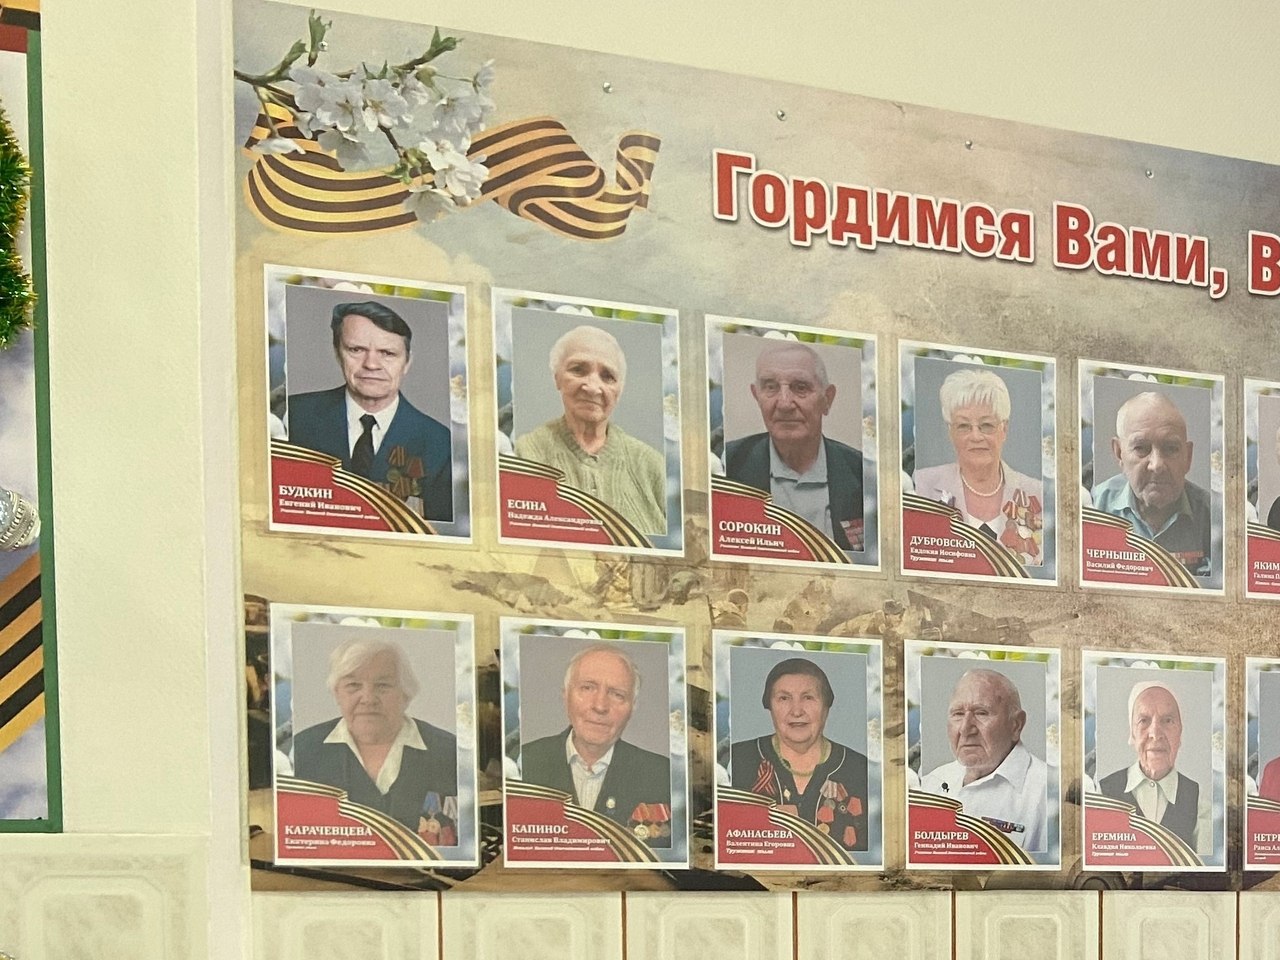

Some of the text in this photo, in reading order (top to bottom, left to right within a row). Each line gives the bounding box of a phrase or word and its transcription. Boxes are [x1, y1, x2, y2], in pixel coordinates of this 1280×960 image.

[713, 150, 1035, 261] Гордимся
[1054, 202, 1227, 296] Вами,
[279, 485, 333, 499] БУДКИН
[507, 499, 547, 511] ЕСИНА
[719, 520, 781, 535] СОРОКИН
[719, 534, 784, 547] Алексей Ильич
[910, 536, 976, 549] ДУБРОВСКАЯ
[1086, 548, 1146, 561] ЧЕРНЫШЕВ
[284, 825, 373, 837] КАРАЧЕВЦЕВА
[512, 824, 569, 834] КАПИНОС
[726, 829, 793, 839] АФАНАСЬЕВА
[914, 831, 969, 841] БОЛДЫРЕВ
[1092, 832, 1137, 841] ЕРЕМИНА
